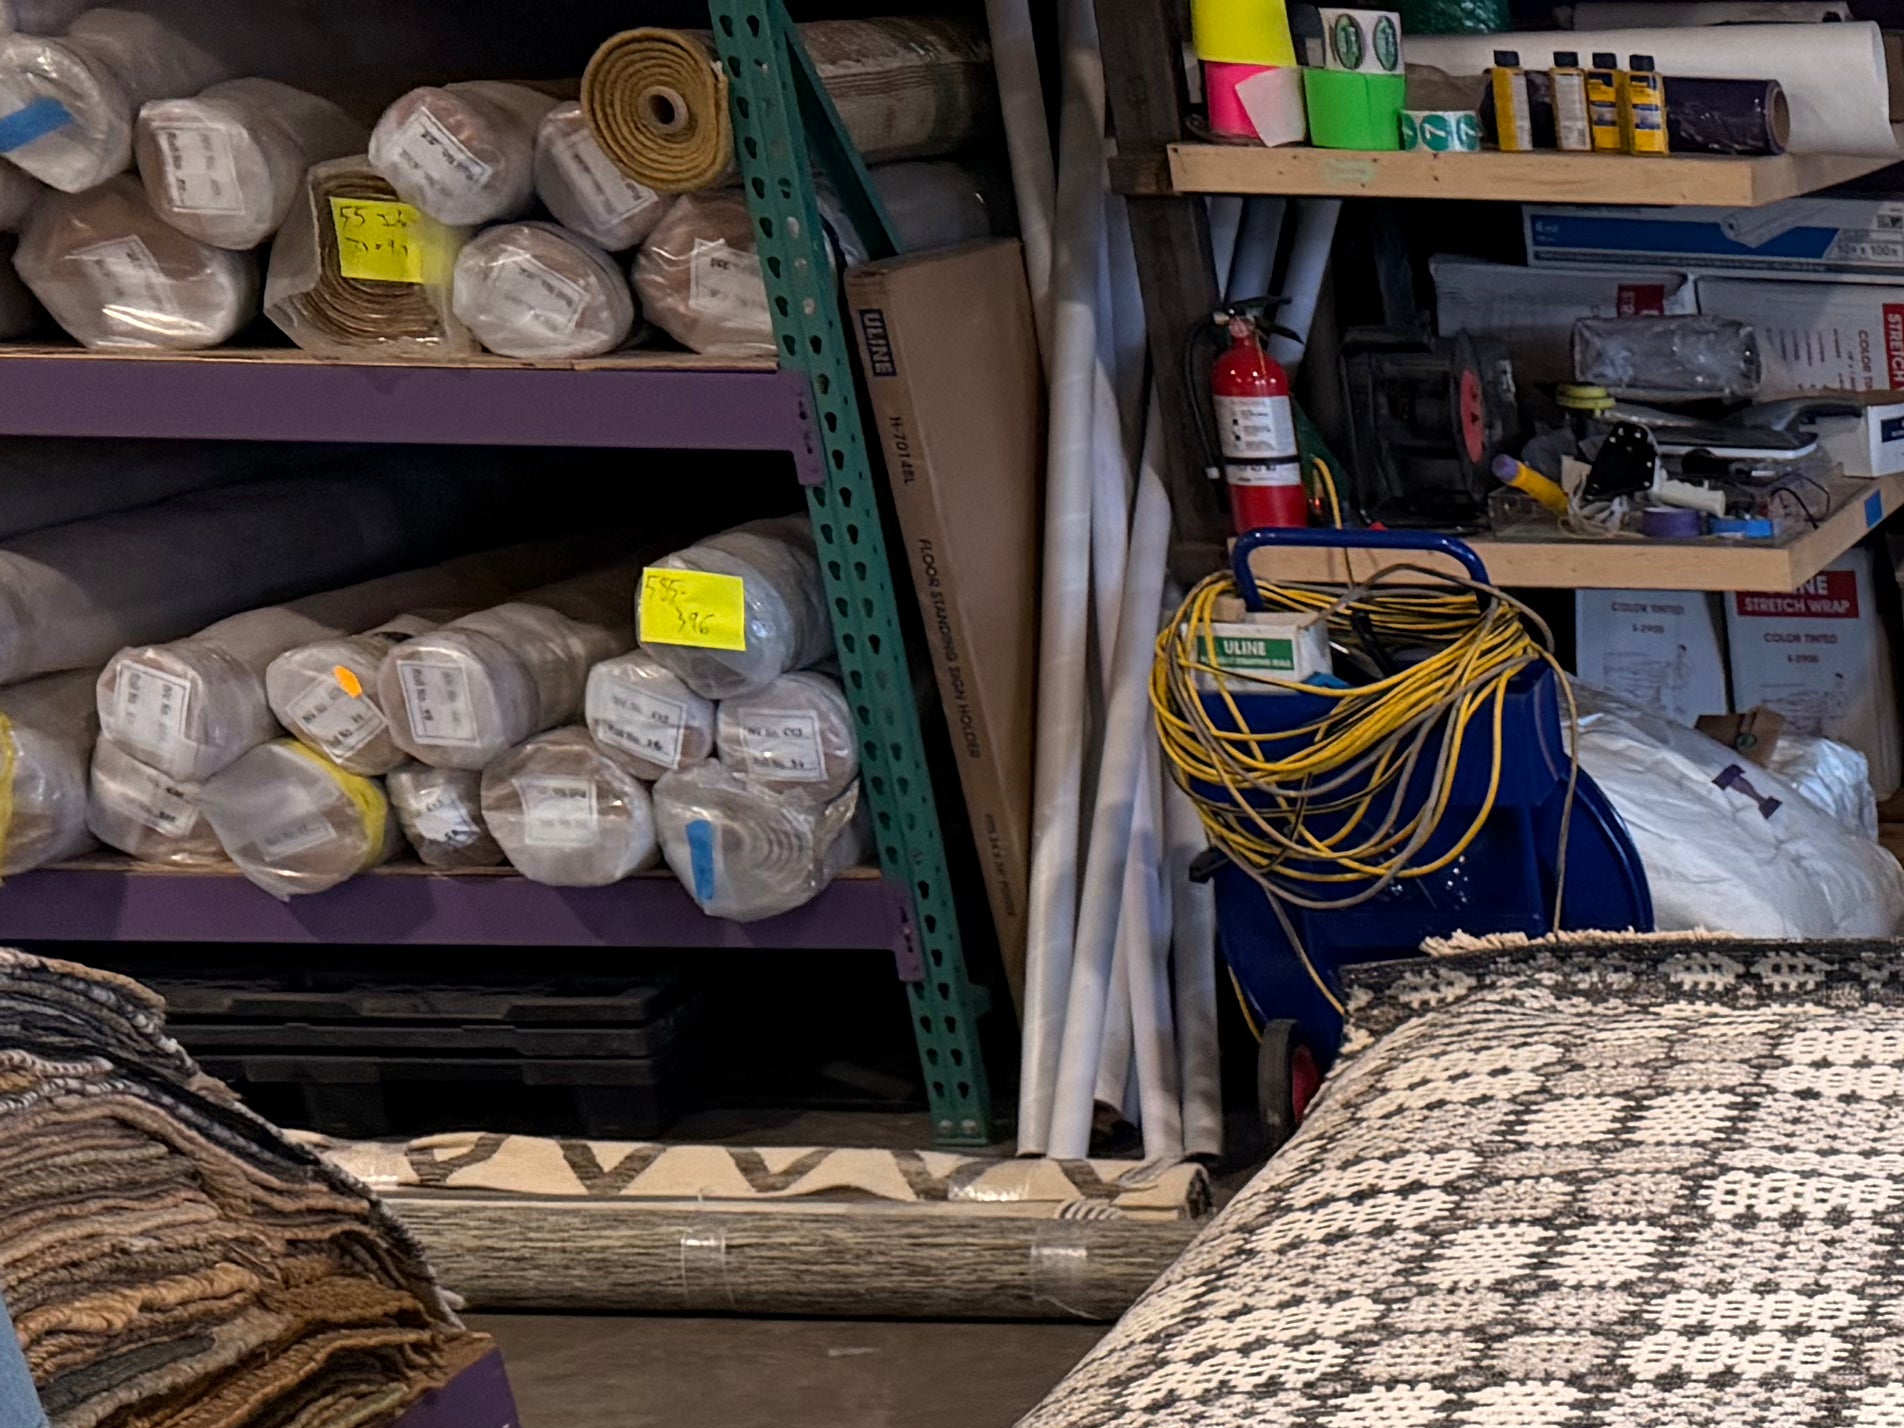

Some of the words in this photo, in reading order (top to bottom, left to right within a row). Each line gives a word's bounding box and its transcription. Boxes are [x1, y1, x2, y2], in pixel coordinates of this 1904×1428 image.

[862, 311, 895, 376] ULINE
[918, 538, 940, 588] FLOOR
[1744, 596, 1805, 613] STRETCH
[1807, 599, 1851, 613] WRAP
[1222, 639, 1268, 657] ULINE
